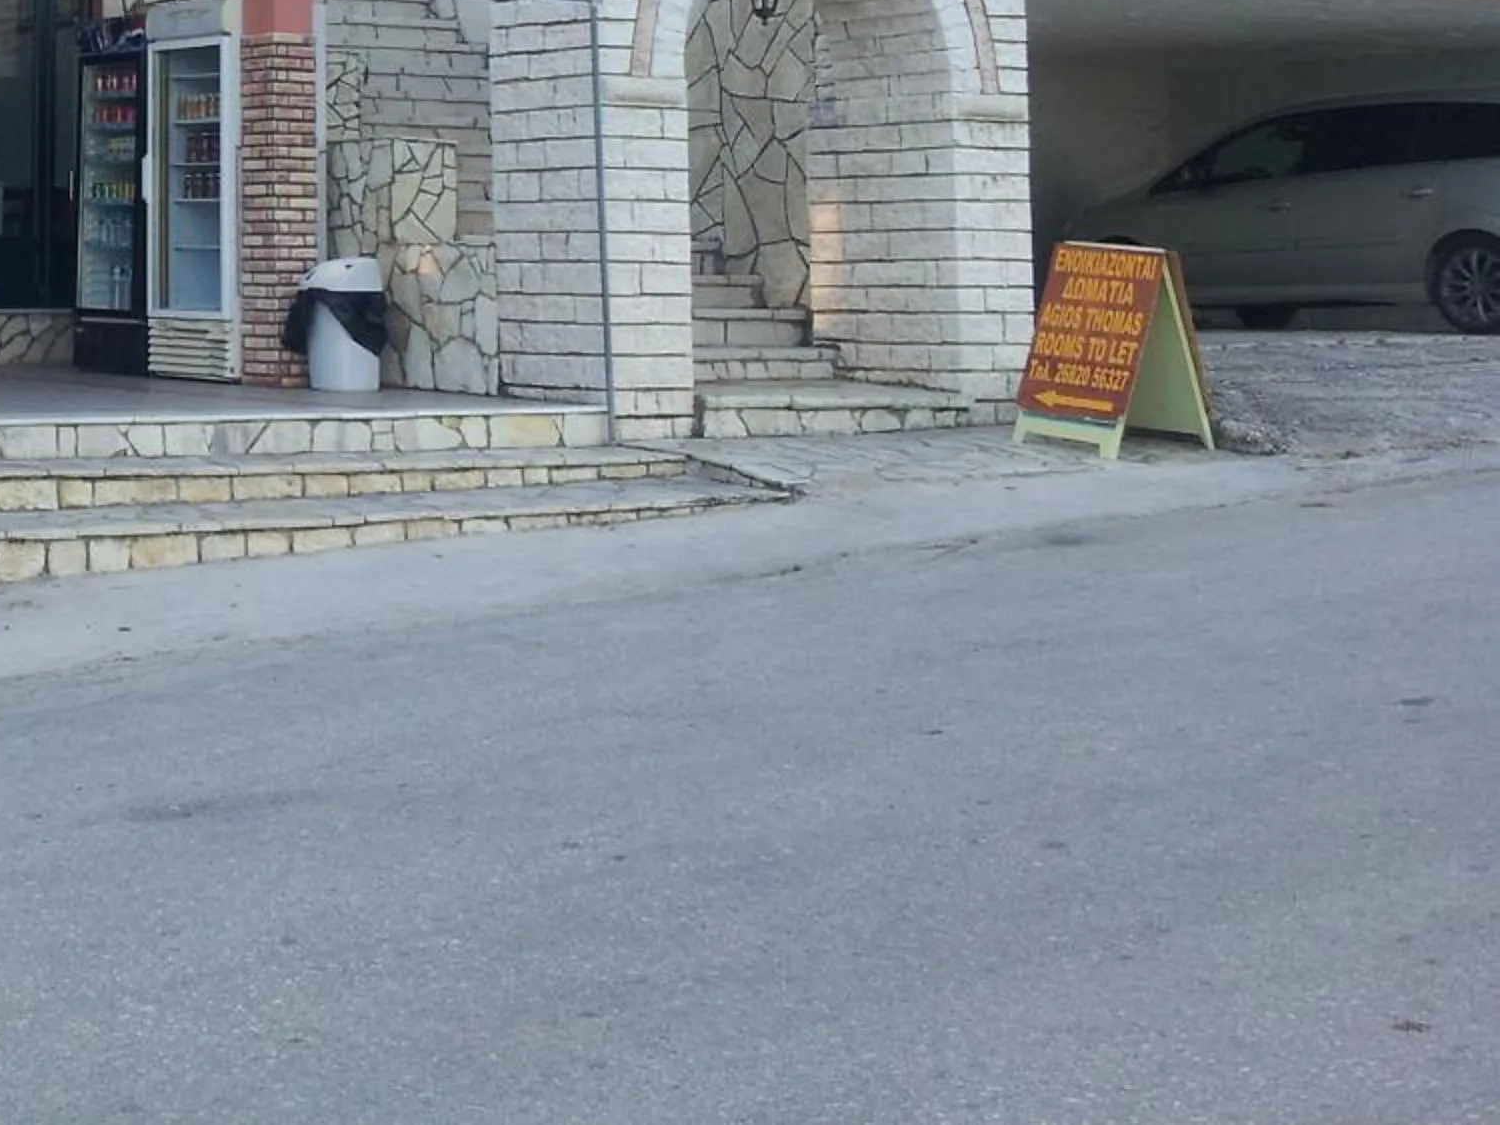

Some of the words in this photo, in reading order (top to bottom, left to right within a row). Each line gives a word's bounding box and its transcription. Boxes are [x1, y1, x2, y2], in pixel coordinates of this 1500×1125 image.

[1061, 276, 1134, 306] ΔΩΜΑΤΙΑ
[1041, 302, 1083, 329] AGIOS
[1086, 308, 1143, 336] THOMAS
[1034, 332, 1083, 359] ROOMS
[1088, 337, 1107, 362] TO
[1108, 340, 1139, 366] LET
